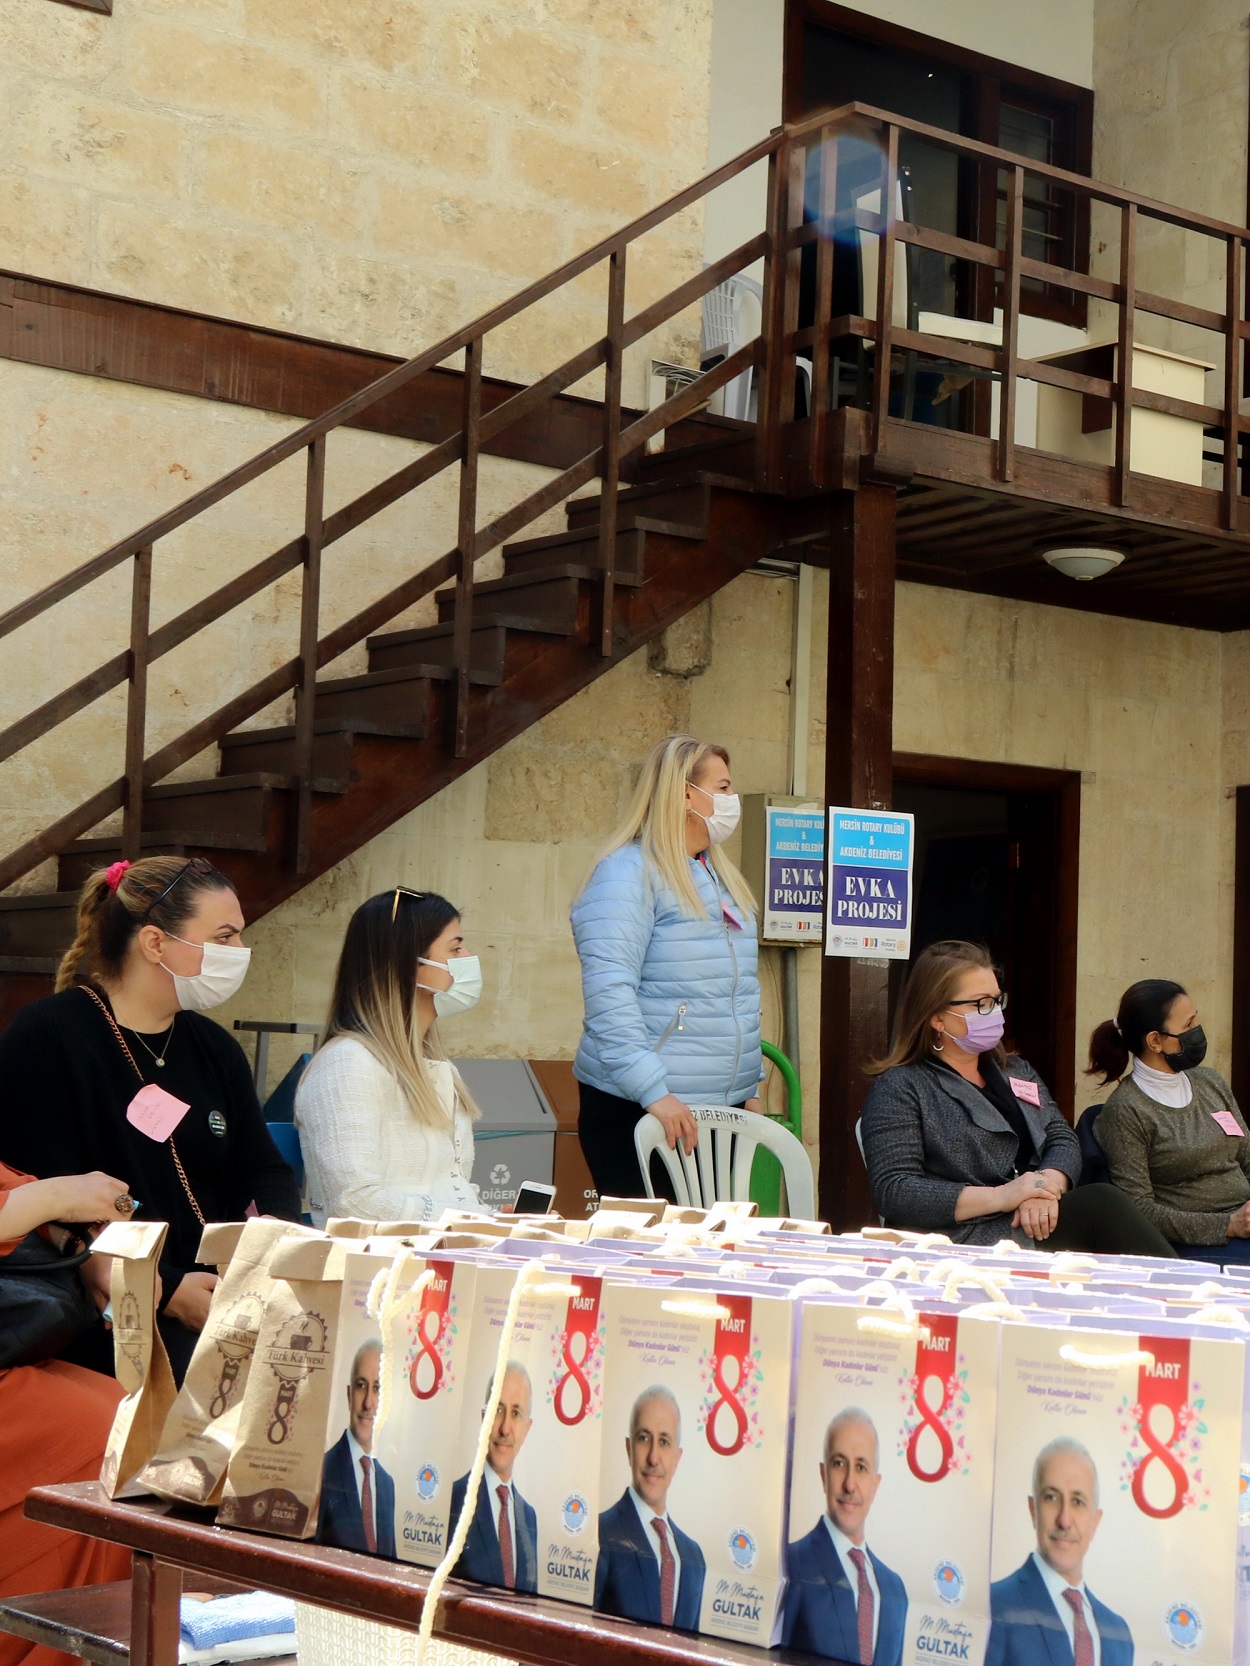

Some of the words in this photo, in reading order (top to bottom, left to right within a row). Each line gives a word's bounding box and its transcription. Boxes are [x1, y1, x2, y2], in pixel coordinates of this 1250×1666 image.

[775, 817, 793, 828] MERSİN
[795, 819, 813, 829] ROTARY
[840, 819, 860, 831] MERSİN
[862, 821, 882, 833] ROTARY
[884, 822, 905, 835] KULÜBÜ
[801, 831, 806, 840] &
[869, 835, 875, 846] &
[776, 841, 800, 852] AKDENİZ
[840, 846, 867, 859] AKDENİZ
[868, 849, 903, 861] BELEDİYESİ
[845, 876, 897, 899] EVKA
[837, 900, 903, 921] PROJESİ
[482, 1188, 516, 1200] DİĞER
[572, 1296, 596, 1311] MART
[720, 1318, 746, 1333] MART
[922, 1336, 951, 1352] MART
[268, 1350, 287, 1361] Türk
[409, 1305, 444, 1400] 8
[822, 1358, 840, 1369] Dünya
[841, 1360, 864, 1370] Kadınlar
[1145, 1363, 1181, 1380] MART
[554, 1328, 591, 1426] 8
[1027, 1384, 1046, 1396] Dünya
[1047, 1387, 1074, 1398] Kadınlar
[707, 1351, 749, 1456] 8
[267, 1399, 293, 1445] 8
[905, 1372, 956, 1482] 8
[1132, 1401, 1189, 1519] 8
